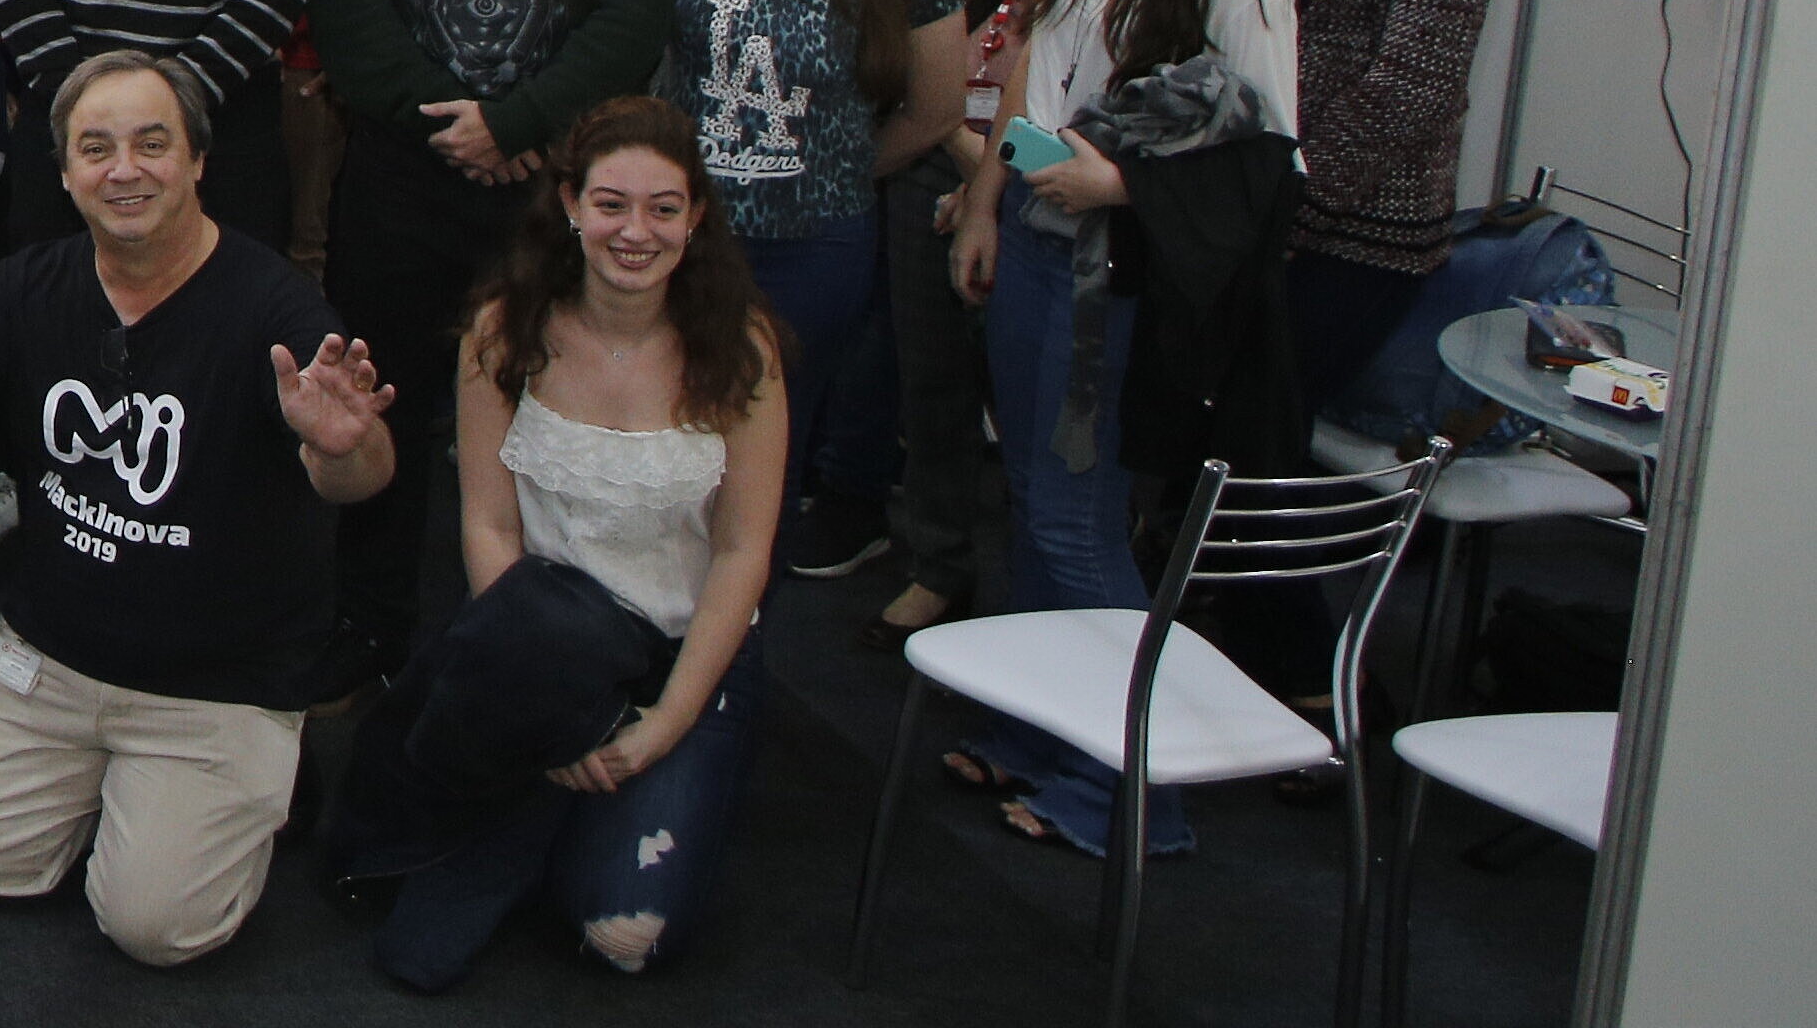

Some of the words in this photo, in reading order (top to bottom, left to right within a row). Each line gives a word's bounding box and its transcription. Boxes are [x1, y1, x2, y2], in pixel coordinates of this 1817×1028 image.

[696, 135, 806, 185] Dodgers
[39, 471, 191, 548] MackInova
[63, 524, 117, 563] 2019
